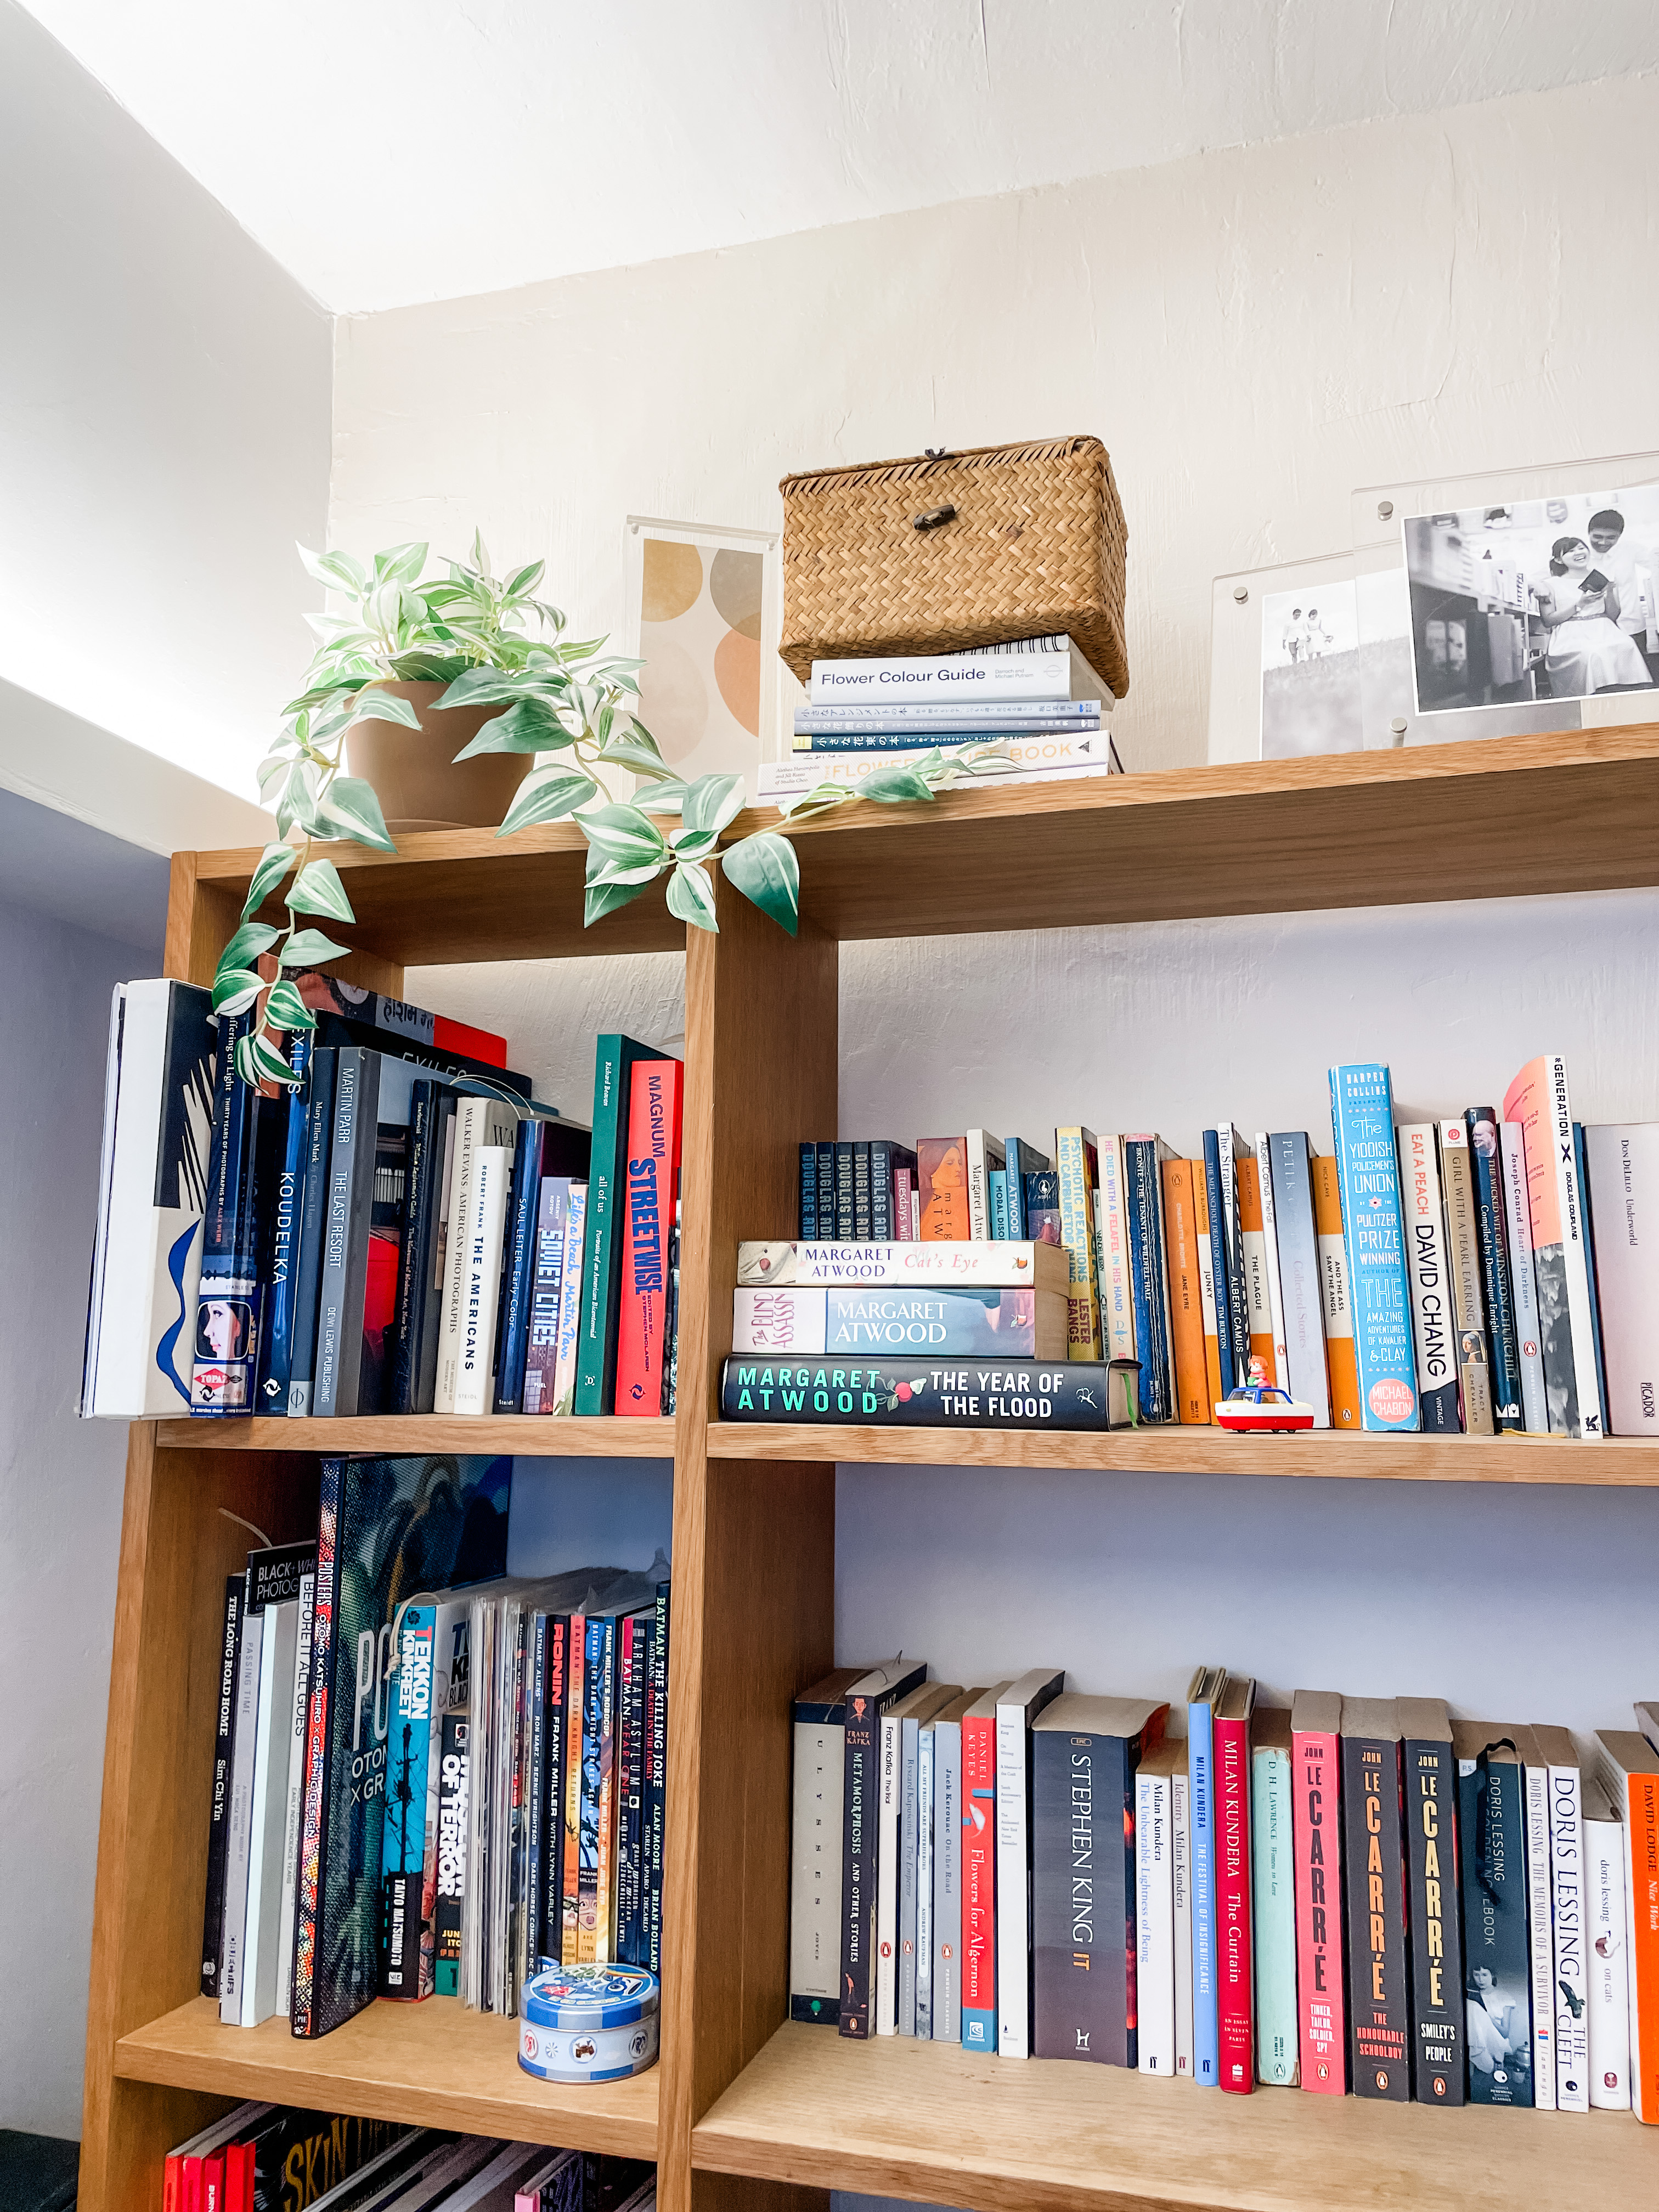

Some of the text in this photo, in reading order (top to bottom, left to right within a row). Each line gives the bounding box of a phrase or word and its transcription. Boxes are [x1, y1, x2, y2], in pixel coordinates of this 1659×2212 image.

[822, 669, 985, 685] Flower Colour Guide
[816, 736, 900, 747] 小さな花束の本
[1010, 743, 1072, 761] BOOK
[1347, 1072, 1384, 1084] HARPER
[1348, 1085, 1386, 1097] COLLINS
[338, 1068, 354, 1143] MARTIN PARR
[649, 1076, 665, 1158] MAGNUM
[1554, 1065, 1571, 1163] GENERATION X
[312, 1101, 323, 1163] Mary Ellen Mark
[1351, 1116, 1382, 1138] The
[223, 1141, 227, 1150] OF
[1350, 1142, 1392, 1158] YIDDISH
[1220, 1130, 1232, 1206] The Stranger
[1352, 1160, 1394, 1172] POLICEMEN'S
[1412, 1134, 1429, 1215] EAT A PEACH
[1453, 1158, 1462, 1183] GIRL
[1355, 1173, 1394, 1193] UNION
[1008, 1186, 1019, 1233] ATWOOD
[1071, 1137, 1086, 1283] PSYCHOTIC REACTIONS
[1455, 1186, 1465, 1217] WITH
[273, 1173, 295, 1284] KOUDELKA
[329, 1171, 347, 1268] THE LAST RESORT
[629, 1158, 662, 1295] STREETWISE
[1105, 1141, 1112, 1153] HE
[1109, 1215, 1119, 1252] FELAFEL
[1114, 1286, 1122, 1311] HAND
[1357, 1213, 1396, 1227] PULITZER
[805, 1249, 893, 1261] MARGARET
[1359, 1230, 1399, 1249] PRIZE
[1459, 1234, 1469, 1266] PEARL
[812, 1265, 885, 1277] ATWOOD
[905, 1254, 978, 1268] Cat's Eye
[1361, 1252, 1400, 1265] WINNING
[1204, 1271, 1213, 1299] JUNKY
[1361, 1279, 1403, 1307] THE
[1415, 1225, 1446, 1376] DAVID CHANG
[1463, 1272, 1474, 1322] EARRING
[465, 1237, 483, 1369] THE AMERICANS
[837, 1302, 947, 1319] MARGARET
[1231, 1276, 1243, 1352] ALBERT CAMUS
[1367, 1311, 1403, 1323] AMAZING
[836, 1323, 946, 1344] ATWOOD
[1368, 1325, 1404, 1334] ADVENTURES
[1368, 1335, 1406, 1345] OF KAVALIER
[738, 1368, 881, 1389] MARGARET
[930, 1371, 1064, 1393] THE YEAR OF
[1372, 1385, 1412, 1399] MICHAEL
[738, 1389, 877, 1414] ATWOOD
[940, 1396, 1052, 1418] THE FLOOD
[1373, 1402, 1410, 1415] CHABON
[1641, 1383, 1654, 1418] PICADOR
[317, 1562, 334, 1606] POSTERS
[296, 1582, 313, 1736] BEFORE IT ALL GOES
[399, 1629, 415, 1718] KINKREET
[411, 1626, 432, 1719] TEKKON
[552, 1624, 563, 1705] RONIN
[307, 1614, 326, 1838] OTOMO KATSUHIRO GRAPHIC DESIGN
[630, 1643, 643, 1785] ARKHAM ASYLUM
[214, 1760, 226, 1821] Sim Chi Yin
[1307, 1767, 1321, 1785] LE
[1365, 1772, 1380, 1792] LE
[1421, 1775, 1437, 1796] LE
[851, 1753, 862, 1854] METAMORPHOSIS
[1224, 1740, 1239, 1877] MILAN KUNDERA
[1154, 1784, 1163, 1861] Milan Kundera
[1489, 1778, 1505, 1881] DORIS LESSING
[1644, 1785, 1656, 1871] DAVID LODGE
[1072, 1754, 1093, 1971] STEPHEN KING IT
[1173, 1784, 1186, 1908] Identity Milan Kundera
[1555, 1778, 1579, 1976] DORIS LESSING
[850, 1887, 859, 1918] OTHER
[1198, 1843, 1209, 1994] THE FESTIVAL OF INSIGNIFICANCE
[1600, 1888, 1611, 1922] lessing
[391, 1879, 405, 1966] TAIYO MATSUMOTO
[968, 1849, 984, 1996] Flowers for Algernon
[1228, 1893, 1241, 1983] The Curtain
[850, 1923, 859, 1962] STORIES
[1373, 2012, 1386, 2025] THE
[1421, 2023, 1455, 2040] SMILEY'S
[1426, 2045, 1452, 2062] PEOPLE
[1558, 2016, 1571, 2068] CLEFT
[1575, 2027, 1585, 2058] THE
